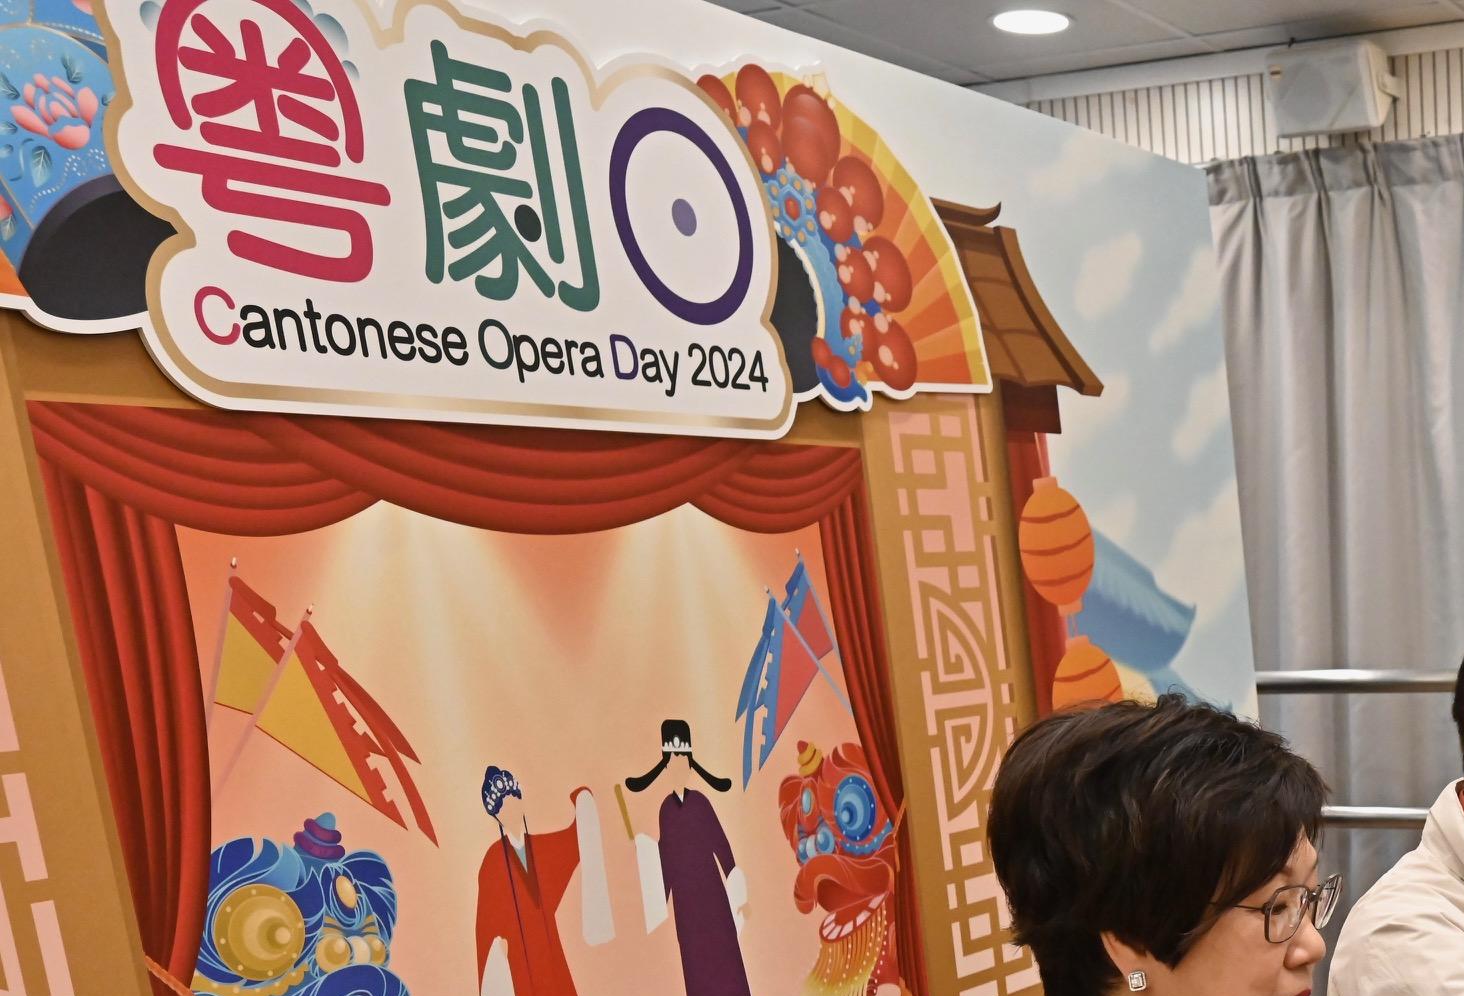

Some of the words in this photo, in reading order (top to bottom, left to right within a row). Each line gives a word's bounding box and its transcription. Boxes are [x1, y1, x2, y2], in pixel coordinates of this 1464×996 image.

[194, 286, 469, 366] Cantonese
[478, 319, 604, 383] Opera
[610, 334, 679, 397] Day
[688, 343, 768, 392] 2024
